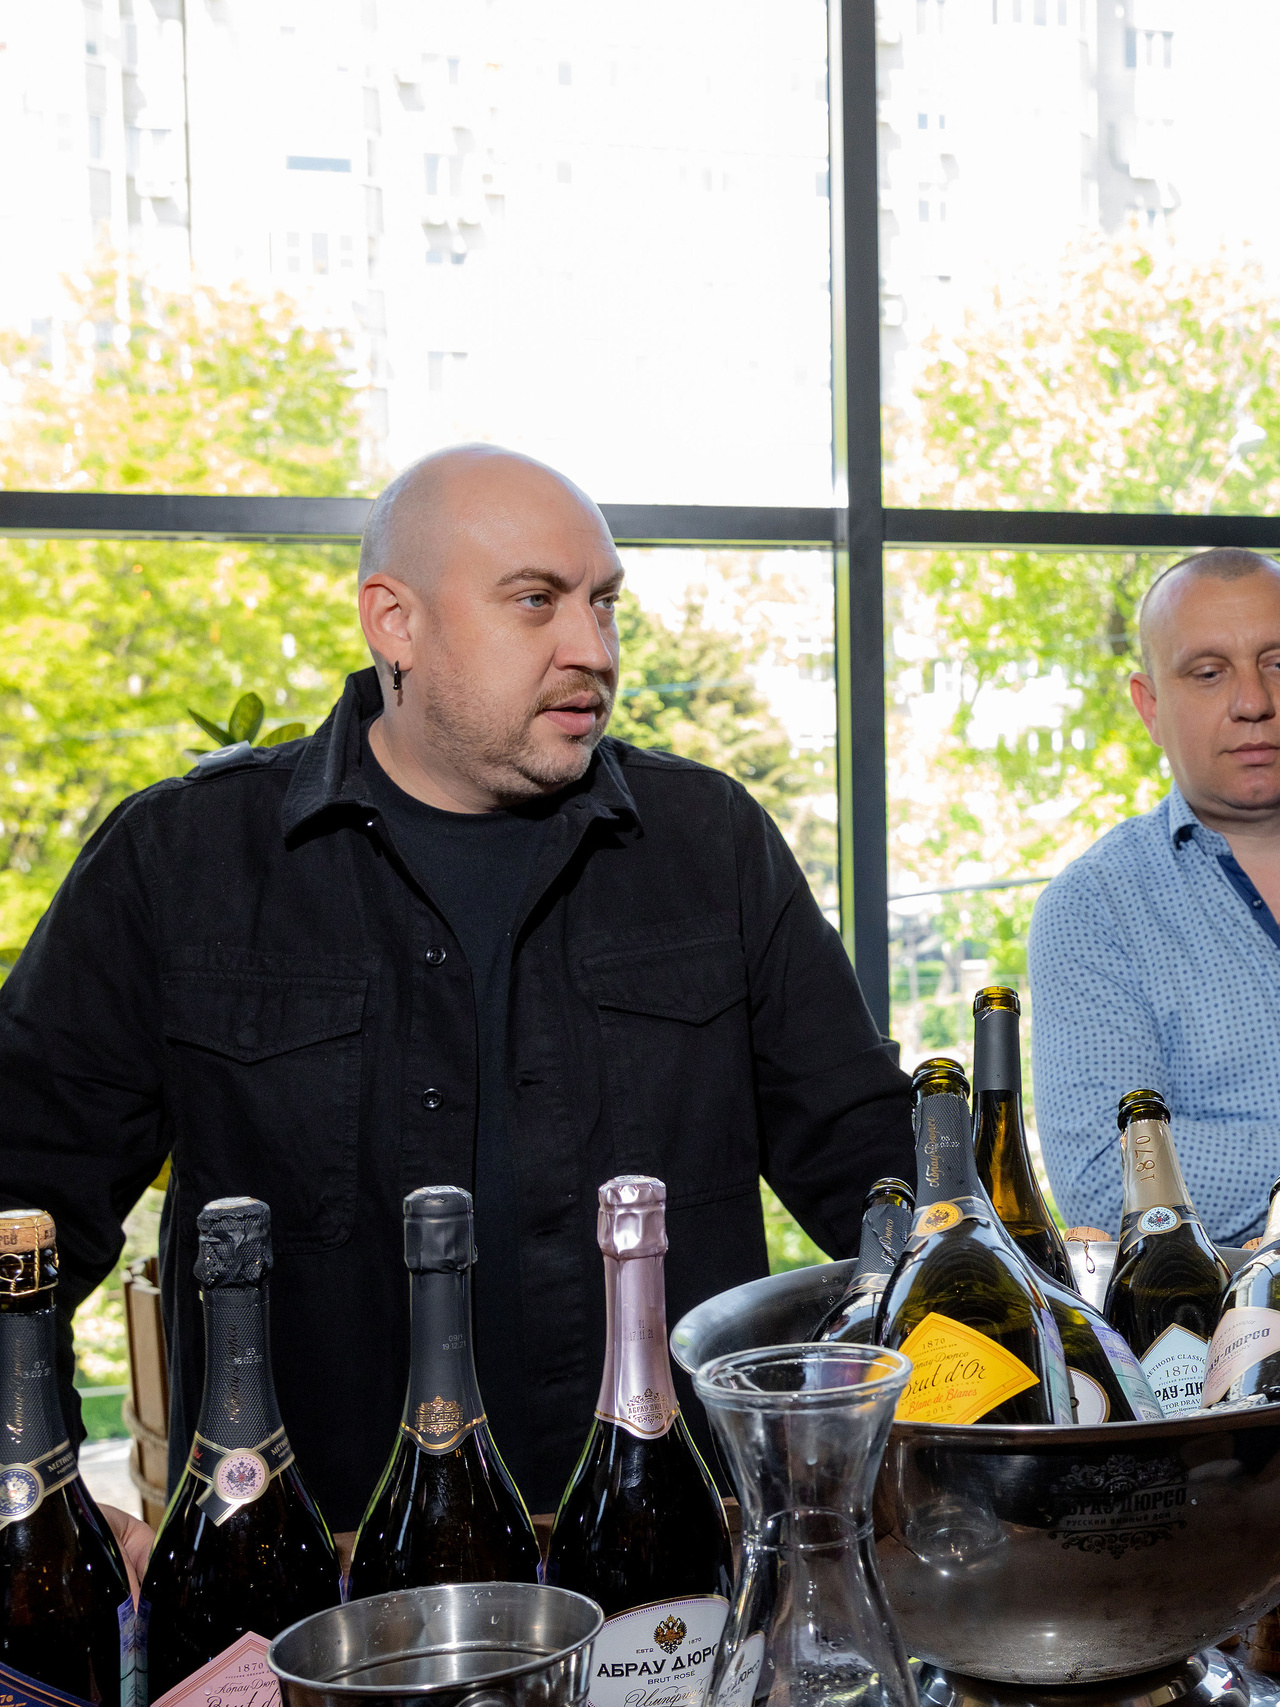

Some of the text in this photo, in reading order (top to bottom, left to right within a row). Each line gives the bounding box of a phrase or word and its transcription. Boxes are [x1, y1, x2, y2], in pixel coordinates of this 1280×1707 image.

[1134, 1135, 1156, 1183] 1870
[922, 1337, 946, 1350] 1870
[913, 1351, 970, 1374] брау-Дюрсо
[1165, 1364, 1198, 1377] 1870
[944, 1359, 987, 1383] d'Or
[905, 1398, 932, 1418] Blanc
[932, 1393, 945, 1404] de
[944, 1388, 978, 1403] Blancs
[926, 1403, 953, 1417] 2018
[1180, 1398, 1201, 1406] DRAV
[688, 1637, 702, 1645] 1870
[238, 1662, 264, 1673] 1870
[597, 1658, 667, 1678] АБРАУ
[647, 1669, 696, 1685] BRUT ROSÉ
[214, 1678, 277, 1697] Абрау-Дюр
